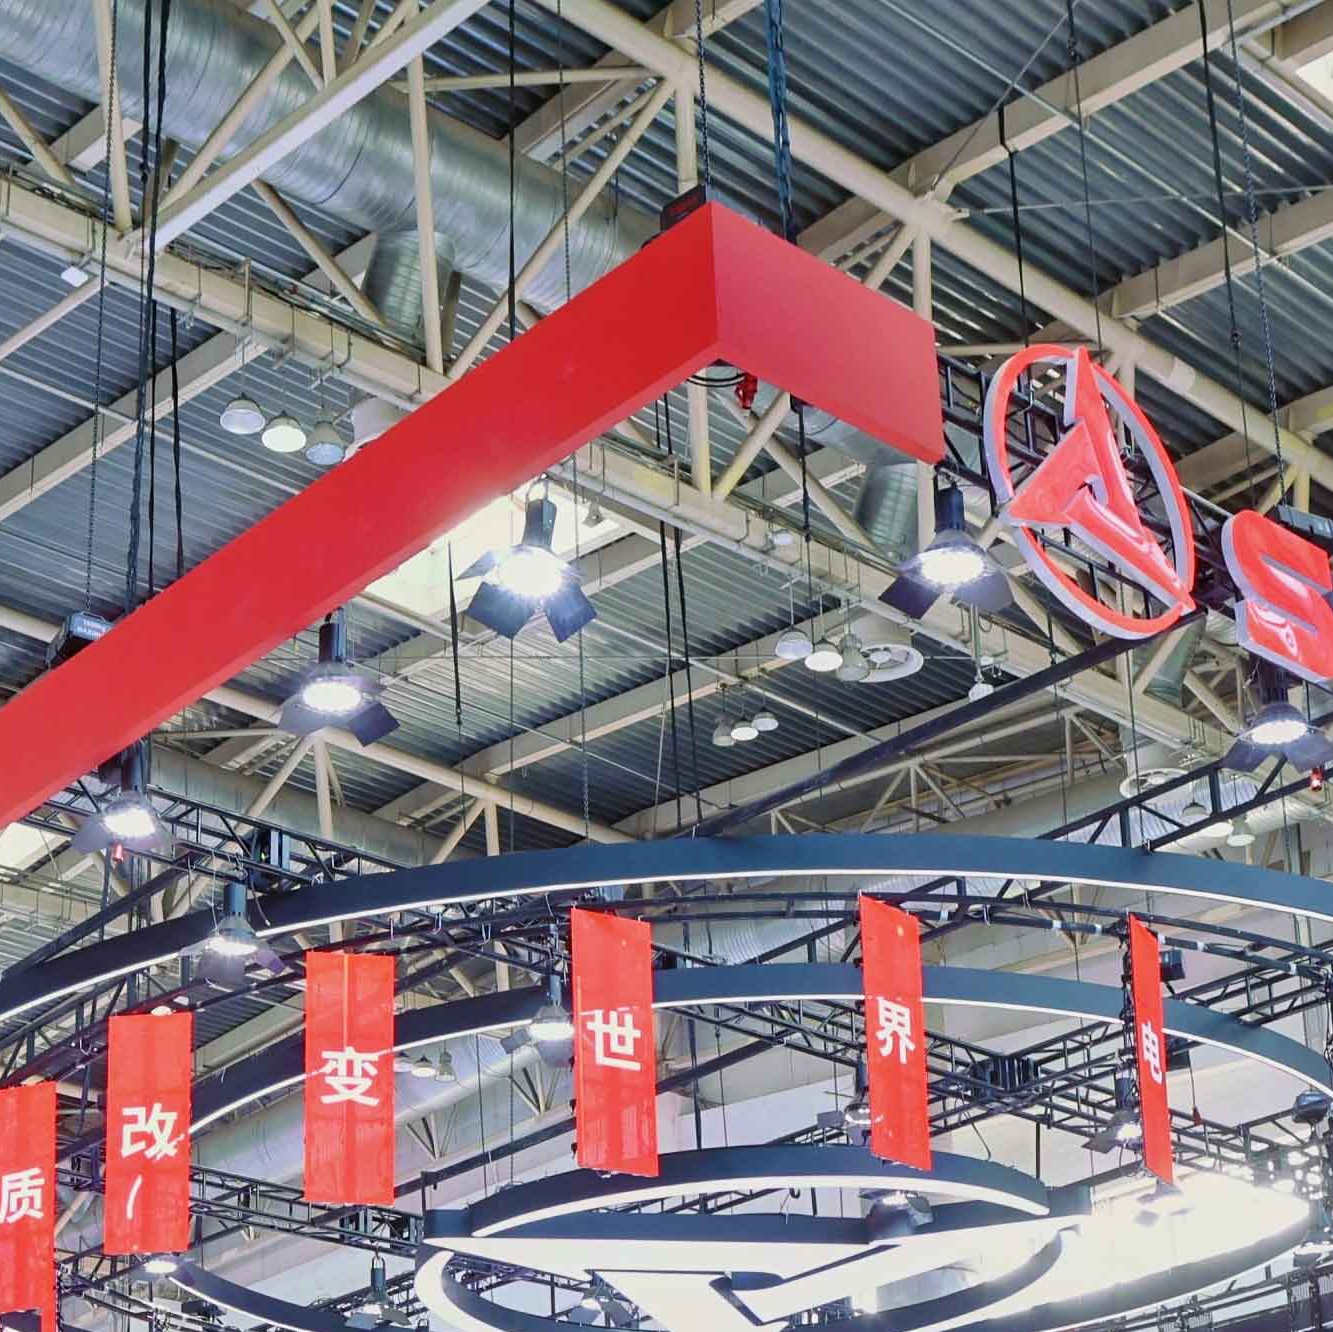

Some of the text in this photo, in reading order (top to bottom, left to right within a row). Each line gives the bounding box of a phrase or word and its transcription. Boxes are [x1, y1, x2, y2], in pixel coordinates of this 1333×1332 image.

[586, 1009, 641, 1072] 世
[877, 998, 915, 1064] 界
[319, 1046, 381, 1108] 变
[120, 1102, 179, 1160] 改
